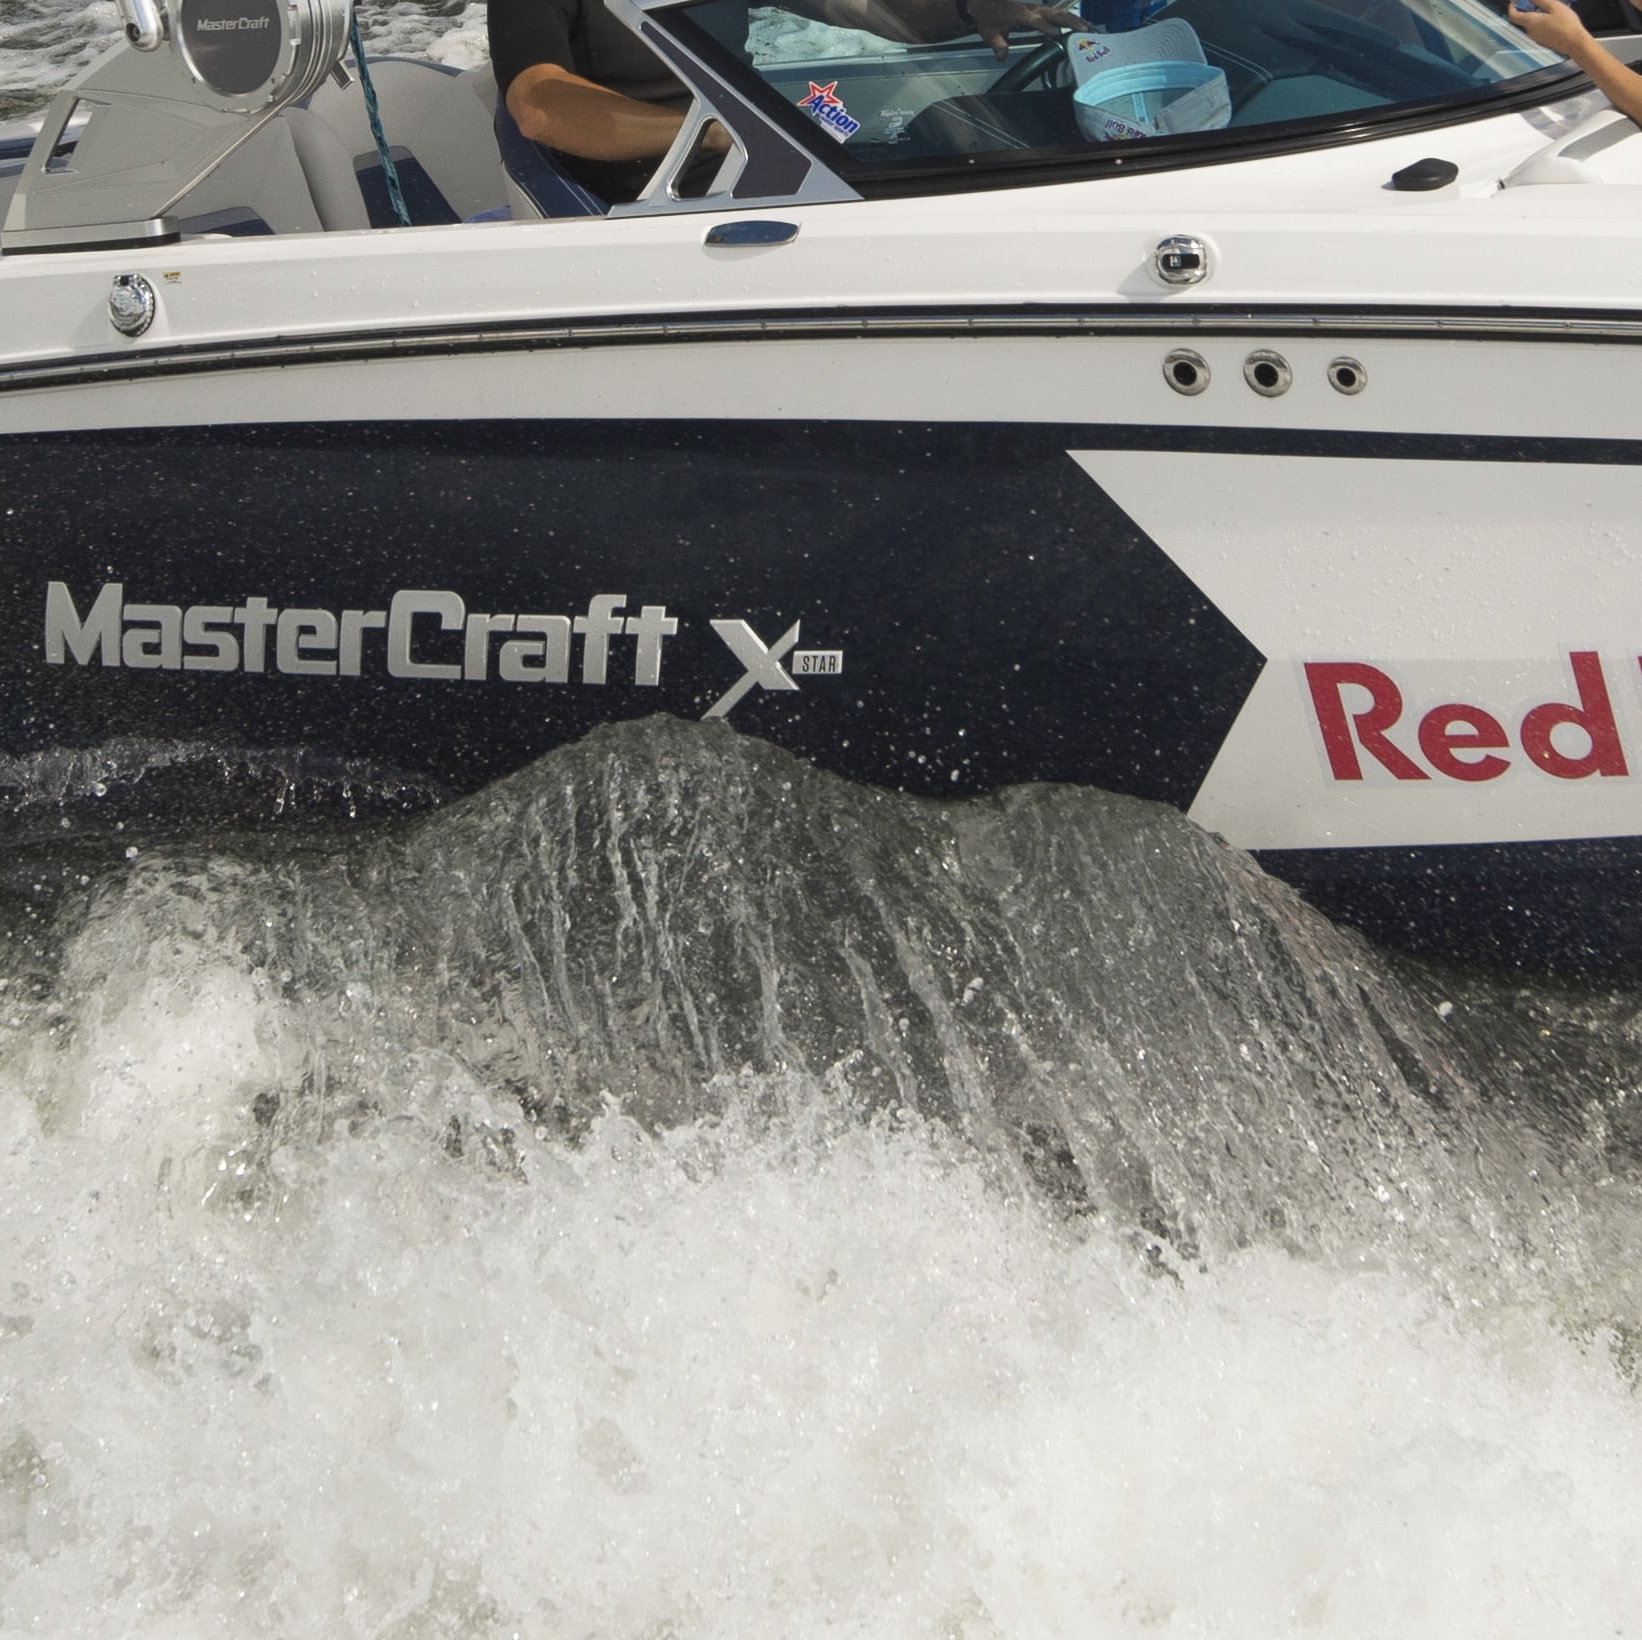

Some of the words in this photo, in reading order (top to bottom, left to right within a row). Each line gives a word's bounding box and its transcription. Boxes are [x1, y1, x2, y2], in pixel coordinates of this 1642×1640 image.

[197, 16, 269, 32] MasterCraft
[807, 94, 859, 134] Action
[45, 581, 677, 686] MasterCraft
[802, 655, 837, 673] STAR
[1303, 651, 1630, 782] Red
